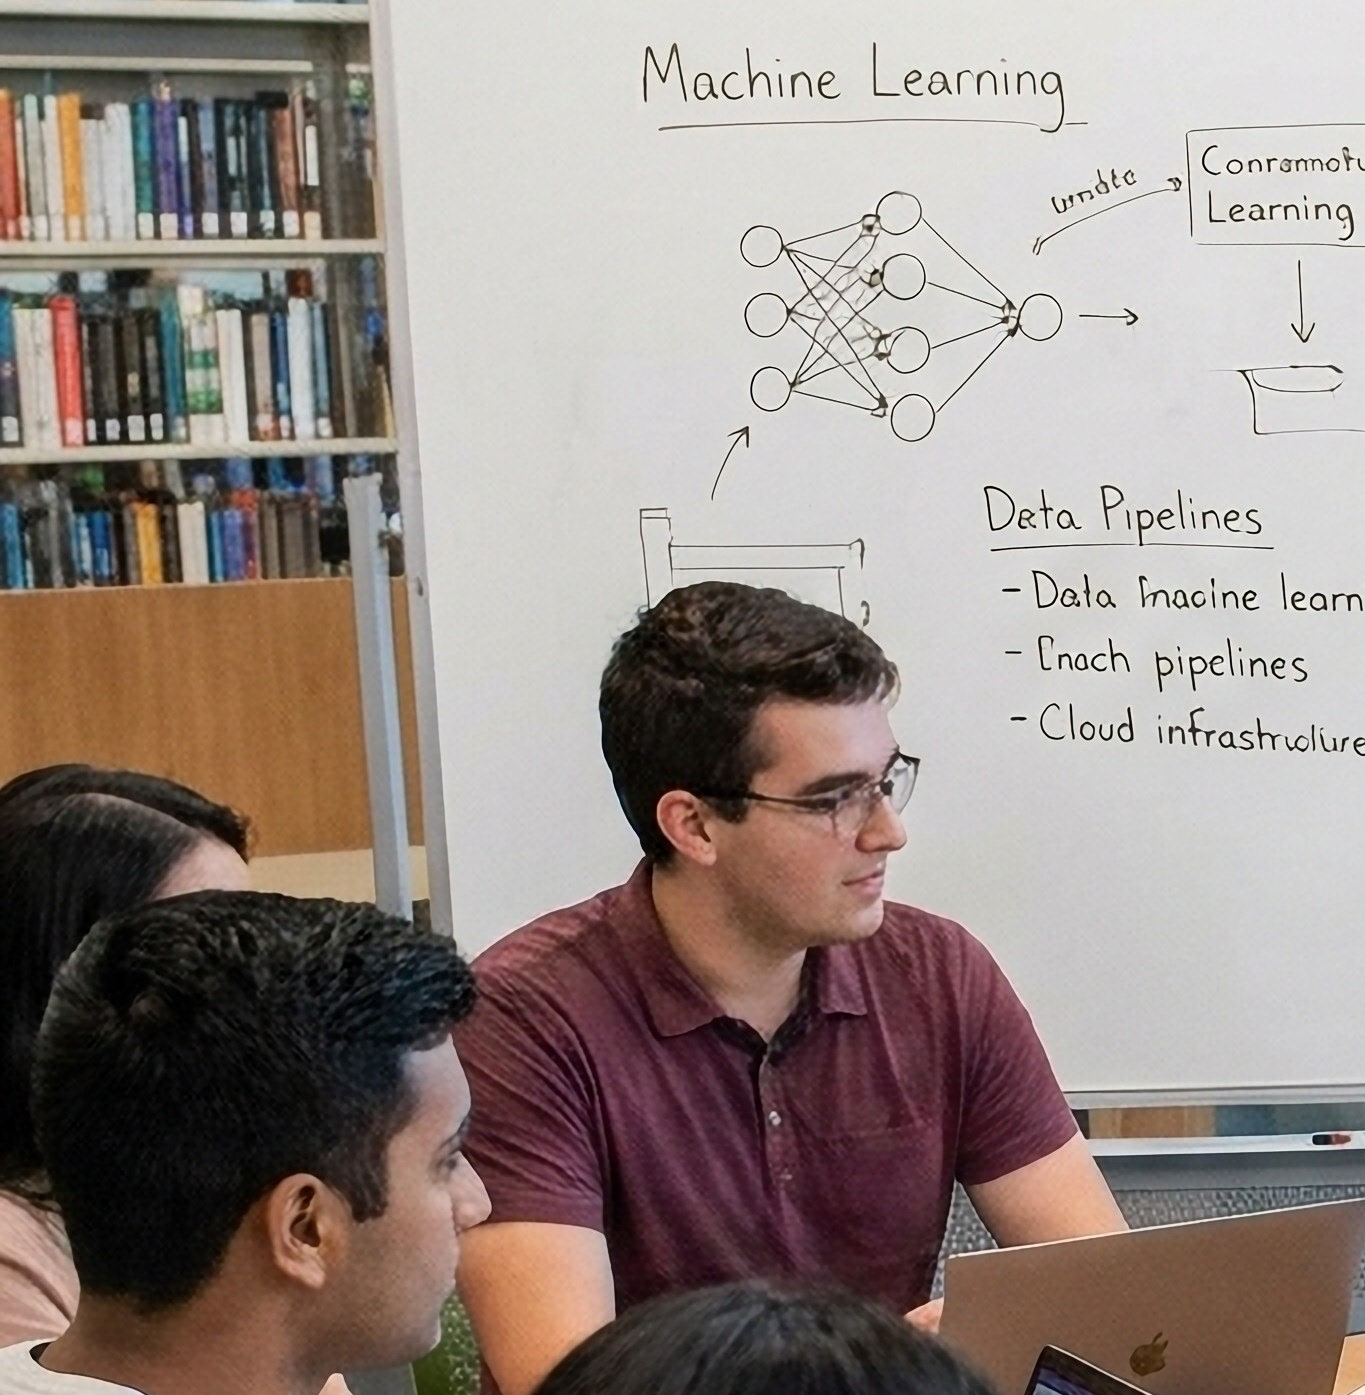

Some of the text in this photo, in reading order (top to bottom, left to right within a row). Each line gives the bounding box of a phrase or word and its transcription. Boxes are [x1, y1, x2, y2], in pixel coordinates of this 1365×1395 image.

[643, 42, 1066, 133] Machine Learning
[1208, 190, 1355, 241] Learning
[984, 485, 1263, 546] Data Pipelines
[1155, 637, 1309, 694] pipelines
[1040, 703, 1135, 742] Cloud
